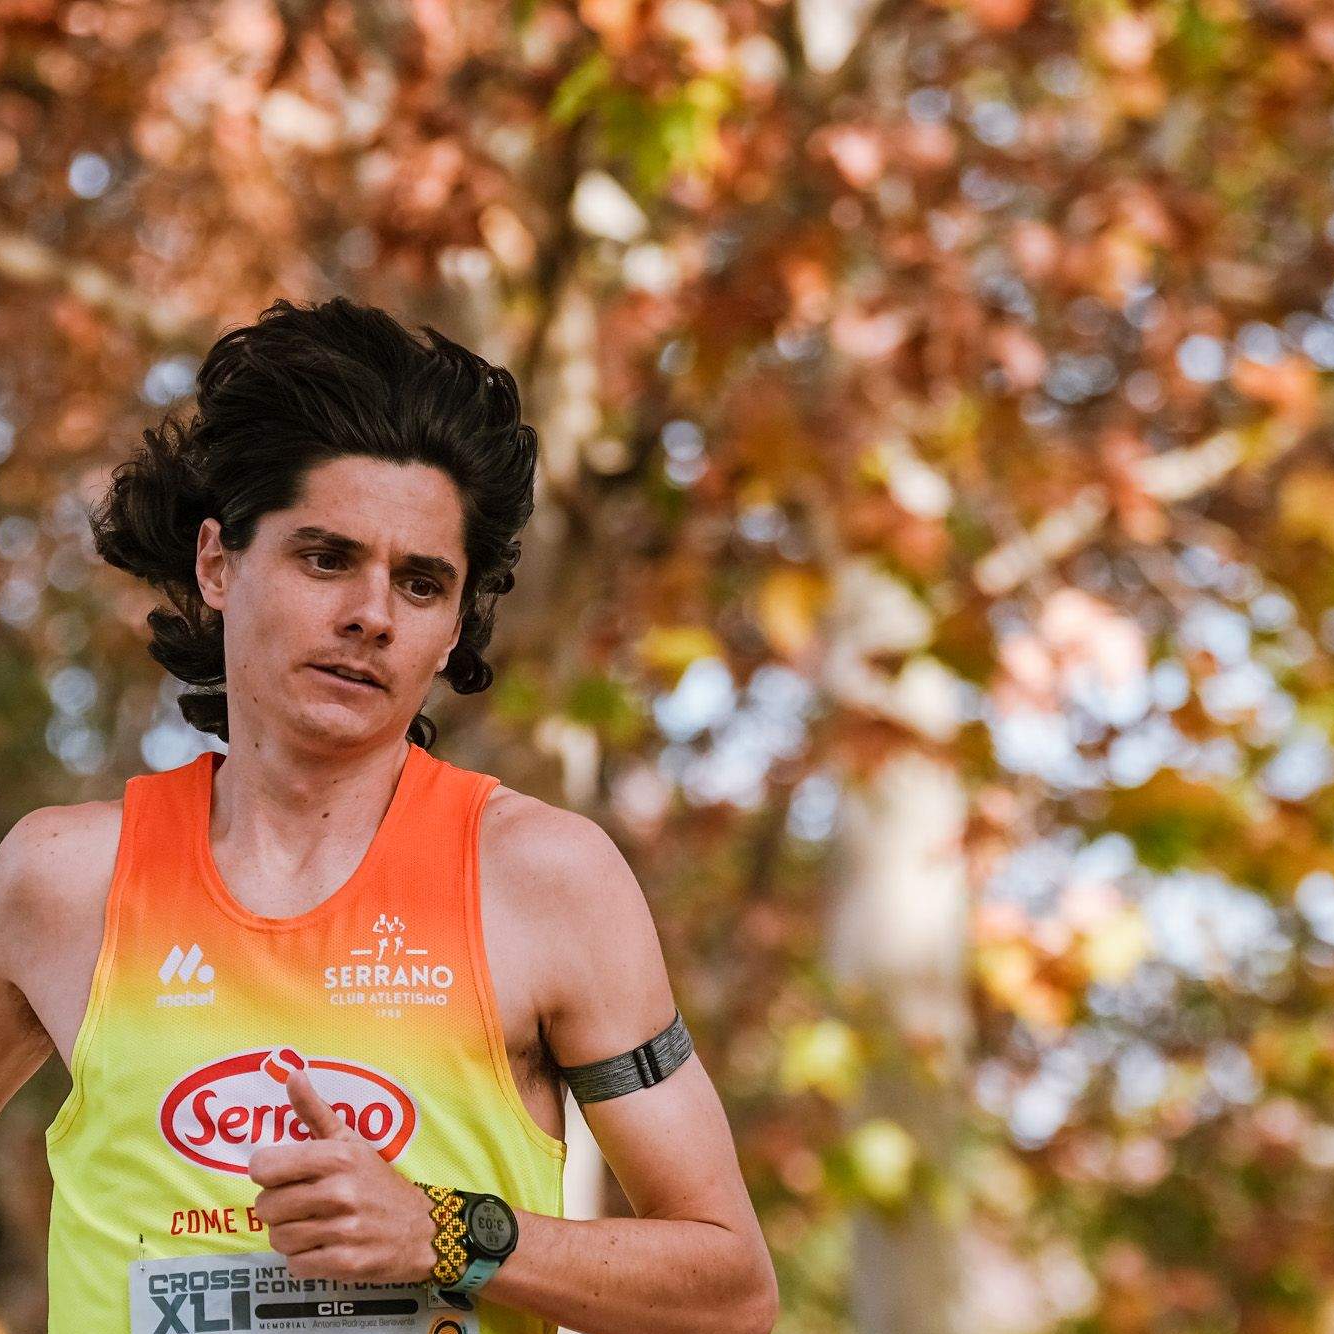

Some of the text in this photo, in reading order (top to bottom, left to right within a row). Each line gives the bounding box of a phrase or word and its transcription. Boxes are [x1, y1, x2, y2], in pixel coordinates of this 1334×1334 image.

[324, 965, 454, 989] SERRANO
[330, 991, 448, 1006] CLUB ATLETISMO
[170, 1207, 238, 1236] COME
[148, 1268, 251, 1295] CROSS
[258, 1321, 307, 1330] MEMORIAL
